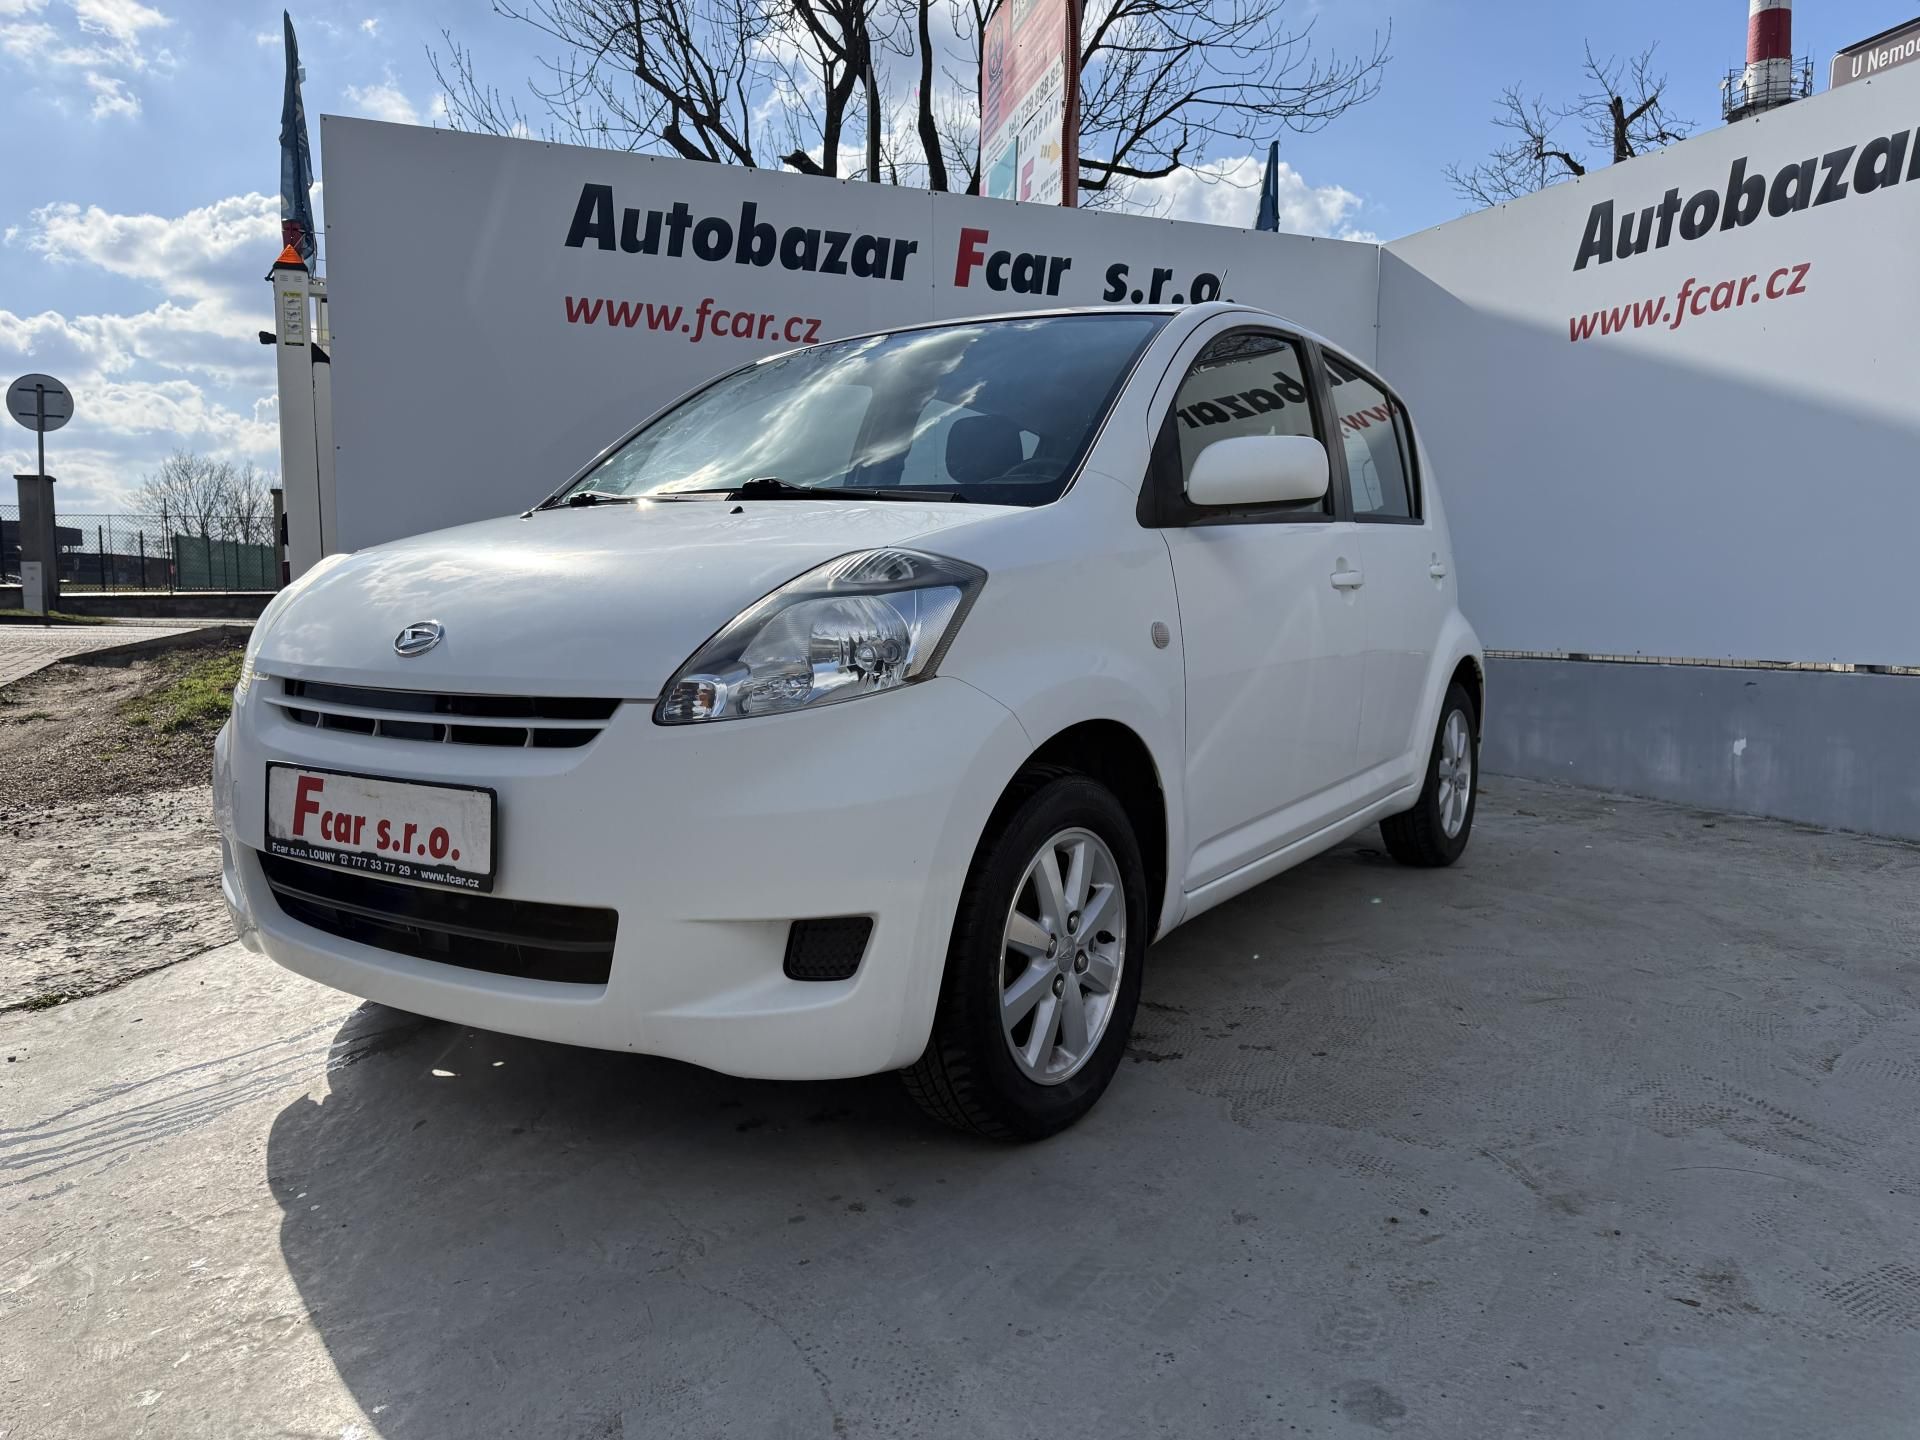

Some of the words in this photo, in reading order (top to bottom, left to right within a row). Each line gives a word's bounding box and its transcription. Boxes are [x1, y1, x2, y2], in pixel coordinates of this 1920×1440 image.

[1851, 54, 1863, 78] U
[564, 182, 919, 281] Autobazar
[954, 227, 1072, 297] Fcar
[564, 295, 822, 344] www.fcar.cz
[1569, 262, 1811, 342] www.fcar.cz
[292, 775, 366, 845] Fcar
[376, 819, 460, 861] s.r.o.
[271, 842, 289, 854] Fcar
[290, 847, 307, 857] s.r.o.
[309, 848, 336, 863] LOUNY
[351, 855, 367, 868] 777
[370, 859, 382, 870] 33
[384, 862, 396, 873] 77
[398, 864, 411, 876] 29
[420, 870, 479, 888] www.fcar.cz
